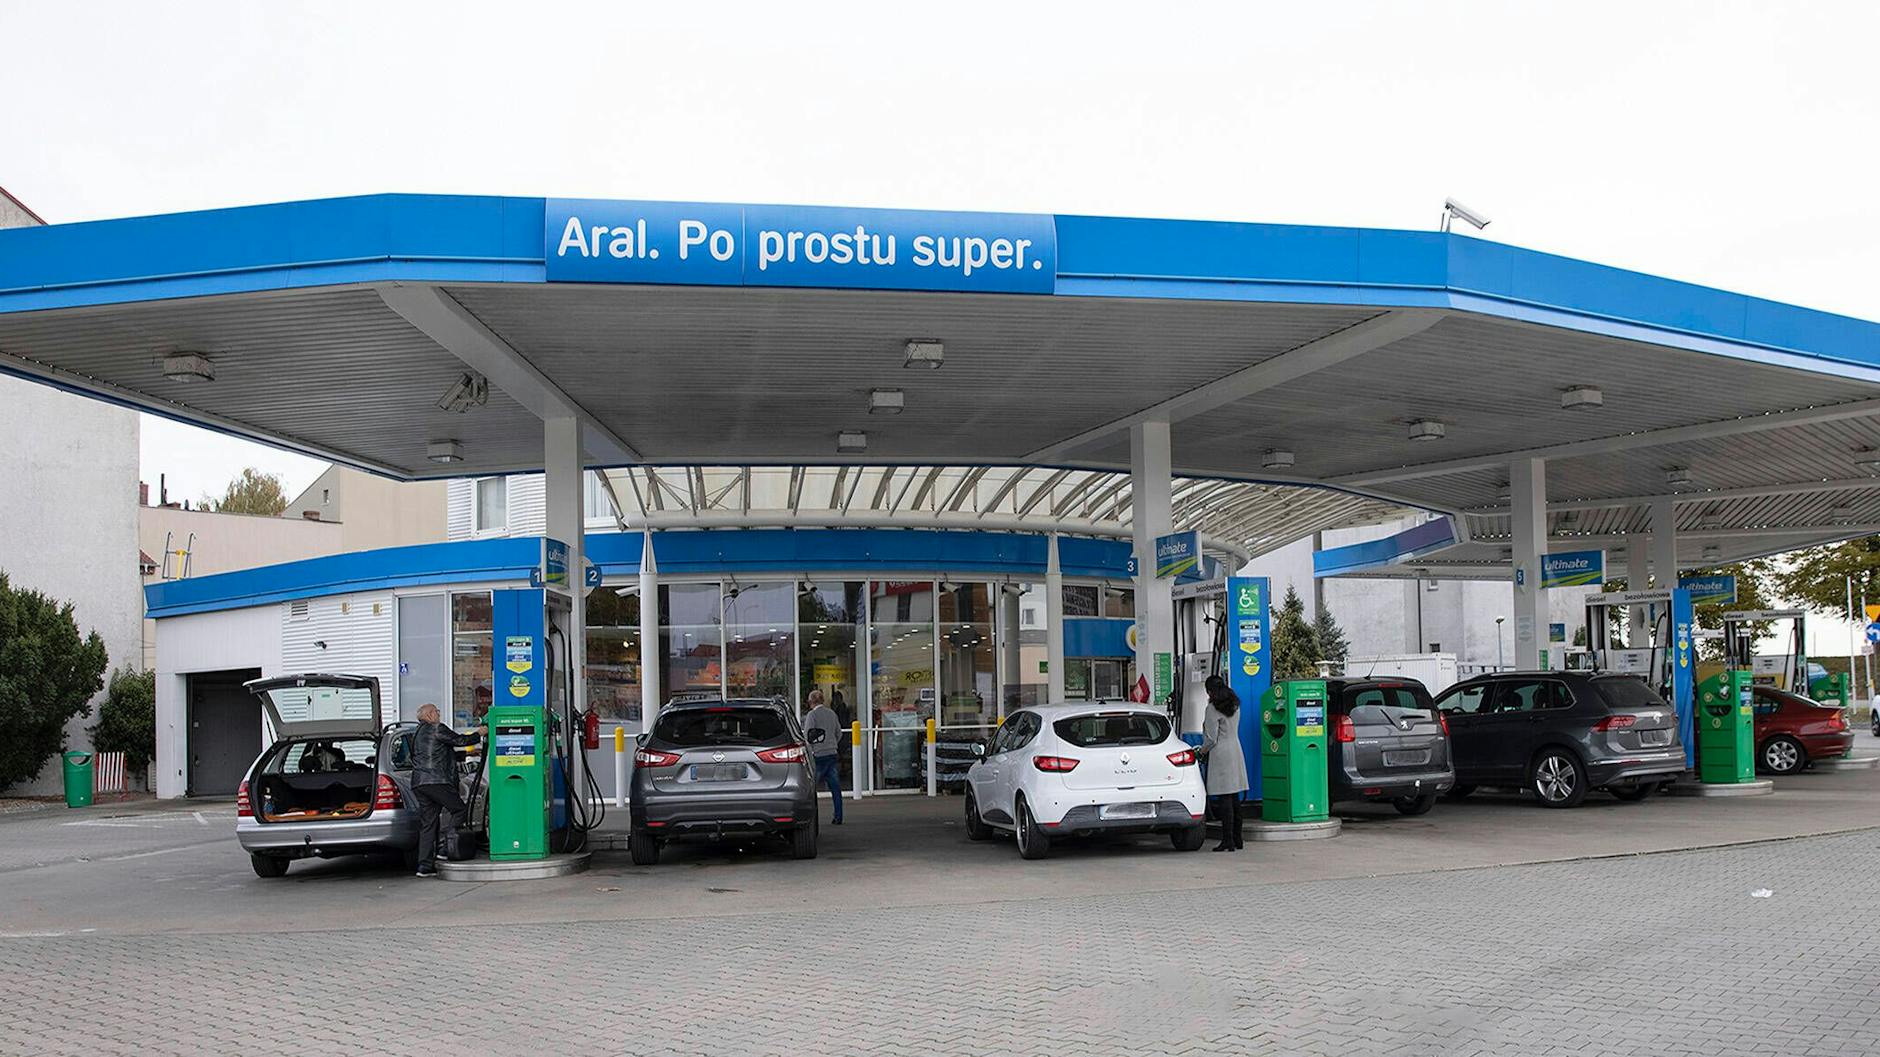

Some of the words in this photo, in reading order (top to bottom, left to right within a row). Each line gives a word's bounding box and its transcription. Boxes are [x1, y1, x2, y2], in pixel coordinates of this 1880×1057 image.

[557, 216, 660, 260] Aral.
[679, 219, 735, 262] Po
[758, 225, 897, 271] prostu
[912, 231, 1043, 277] super.
[1158, 542, 1187, 557] ultimate
[1127, 561, 1135, 572] 3
[1544, 559, 1589, 571] ultimate
[534, 571, 541, 582] 1
[589, 570, 598, 582] 2
